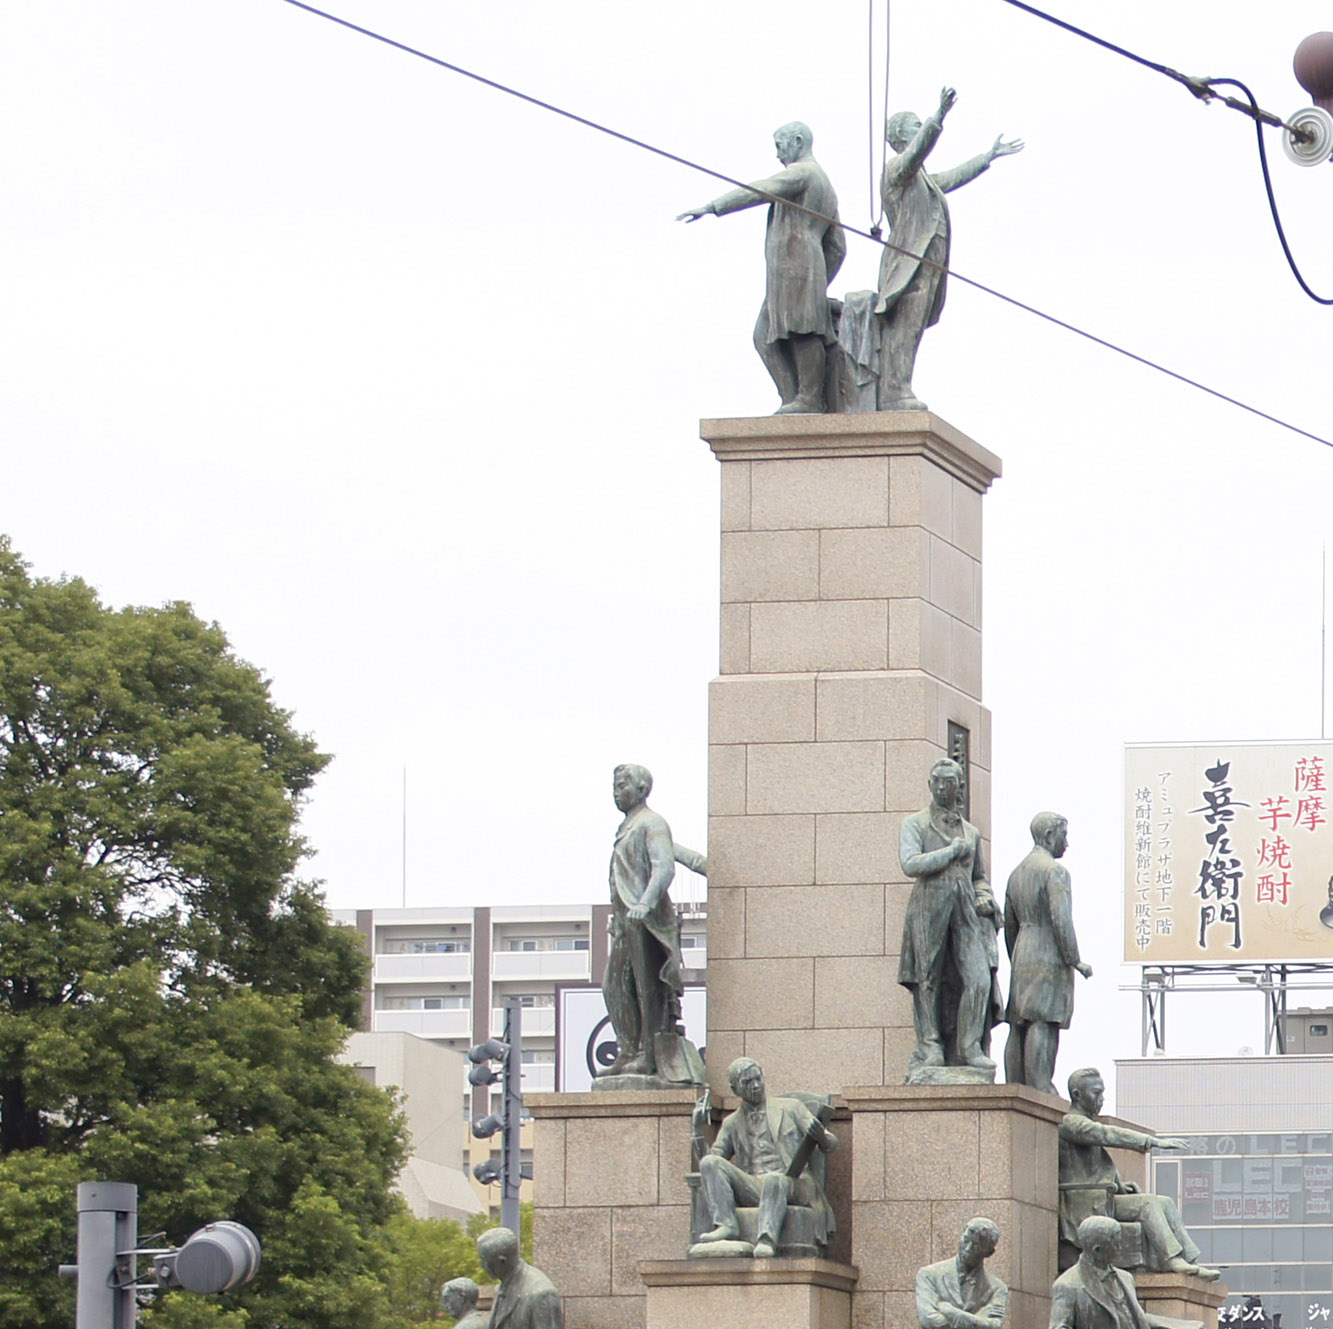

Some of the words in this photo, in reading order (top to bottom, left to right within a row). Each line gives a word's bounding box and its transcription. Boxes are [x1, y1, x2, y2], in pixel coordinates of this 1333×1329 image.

[1155, 771, 1174, 936] アミュプラザ地下一階
[1188, 758, 1250, 950] 喜左衛門
[1256, 796, 1293, 906] 芋焼酎
[1294, 756, 1328, 833] 薩摩
[1135, 788, 1153, 952] 焼酎維新館にて販売中
[1213, 1199, 1290, 1219] 鹿児島本校
